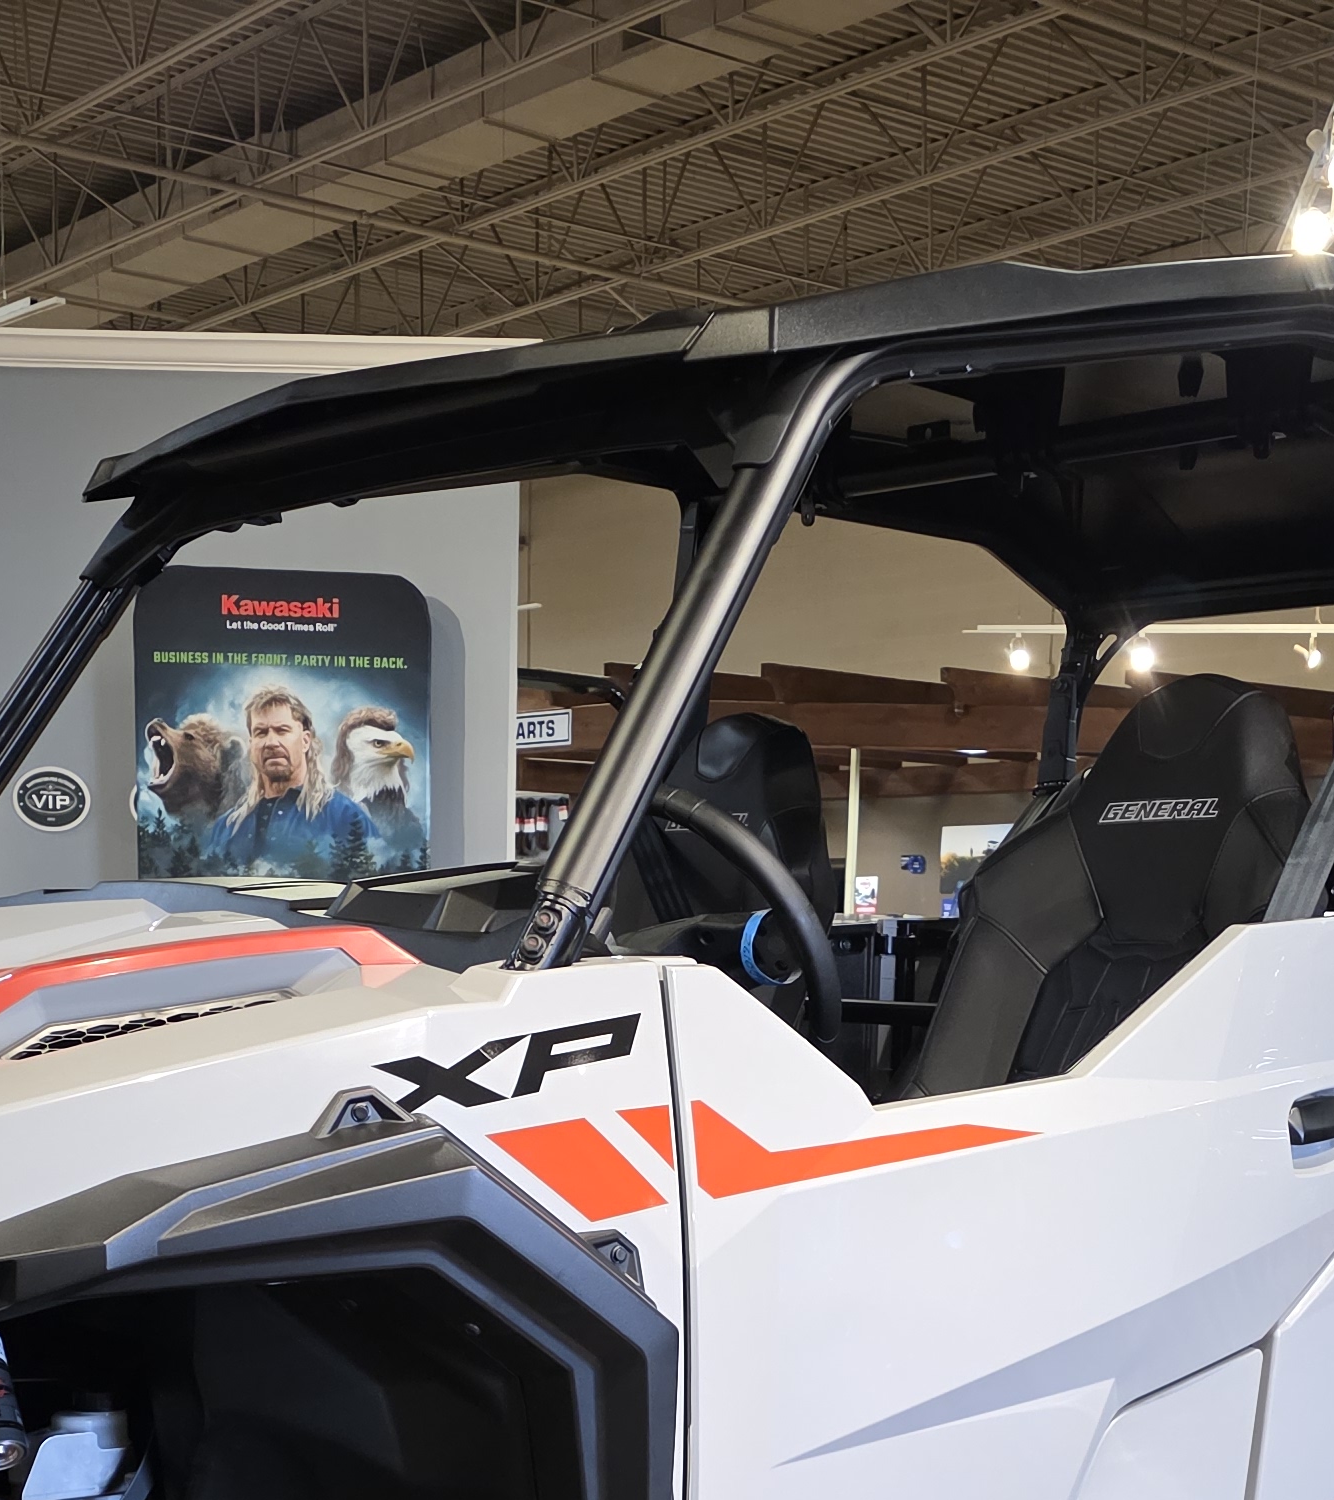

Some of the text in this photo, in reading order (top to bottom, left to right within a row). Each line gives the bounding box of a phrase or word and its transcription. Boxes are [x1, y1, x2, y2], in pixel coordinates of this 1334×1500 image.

[221, 594, 339, 618] Kawasaki
[226, 620, 242, 630] Let
[244, 620, 258, 630] the
[260, 621, 285, 631] Good
[287, 622, 314, 632] Times
[154, 651, 408, 669] BUSINESS IN THE FRONT. PARTY IN THE BACK.
[516, 720, 555, 739] ARTS
[31, 794, 70, 810] VIP
[1097, 797, 1219, 824] GENERAL
[371, 1012, 642, 1113] XP
